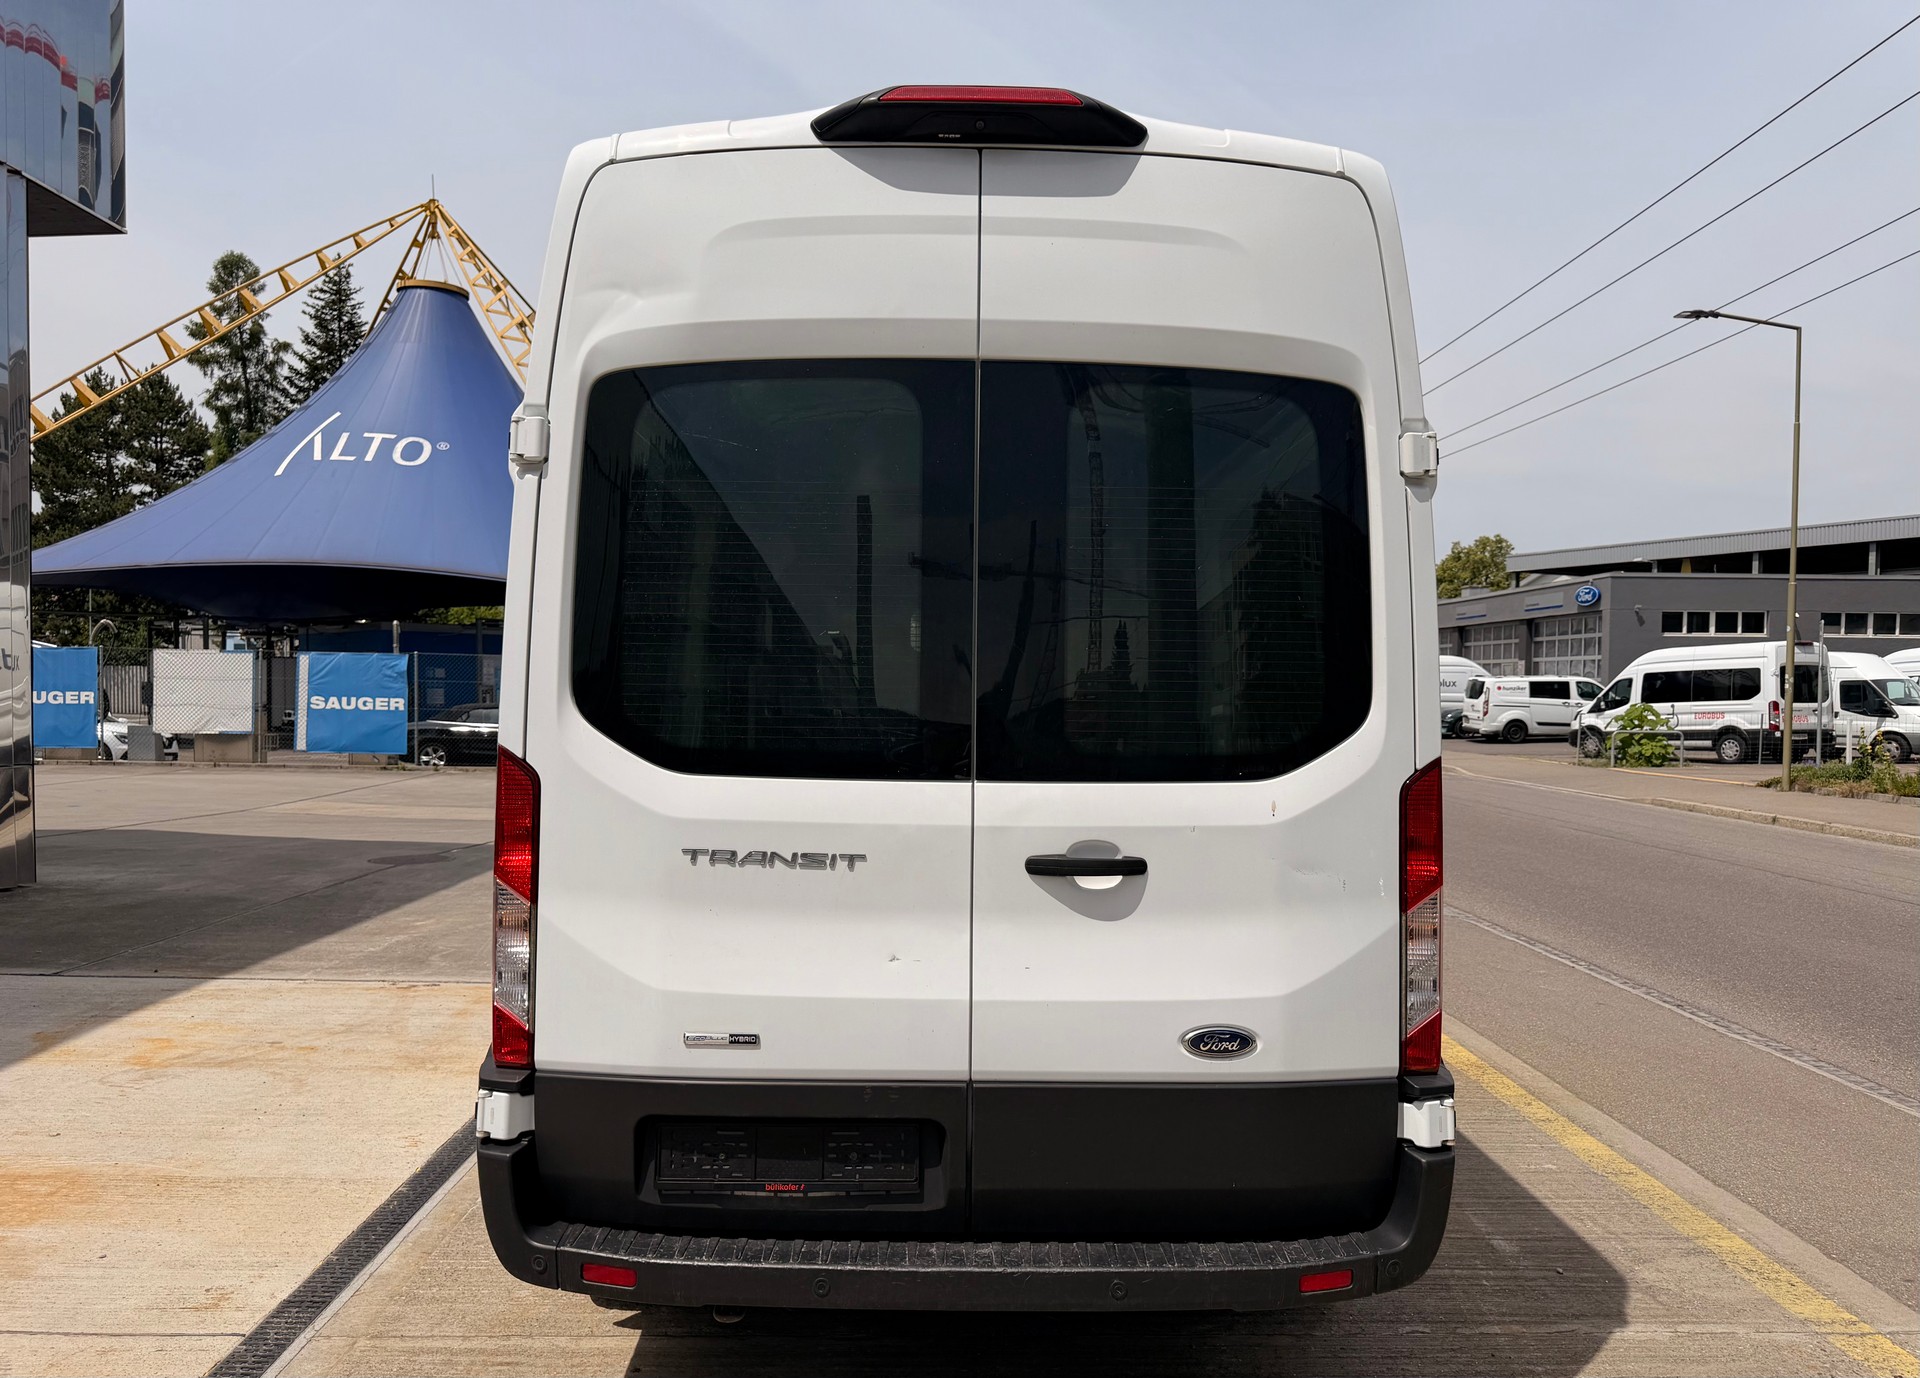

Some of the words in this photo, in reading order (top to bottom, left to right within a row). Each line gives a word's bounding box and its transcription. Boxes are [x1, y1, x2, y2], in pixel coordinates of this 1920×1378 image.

[310, 696, 405, 711] SAUGER
[1694, 711, 1725, 720] EUROBUS
[681, 848, 867, 872] TRANSIT
[1200, 1033, 1241, 1051] Ford
